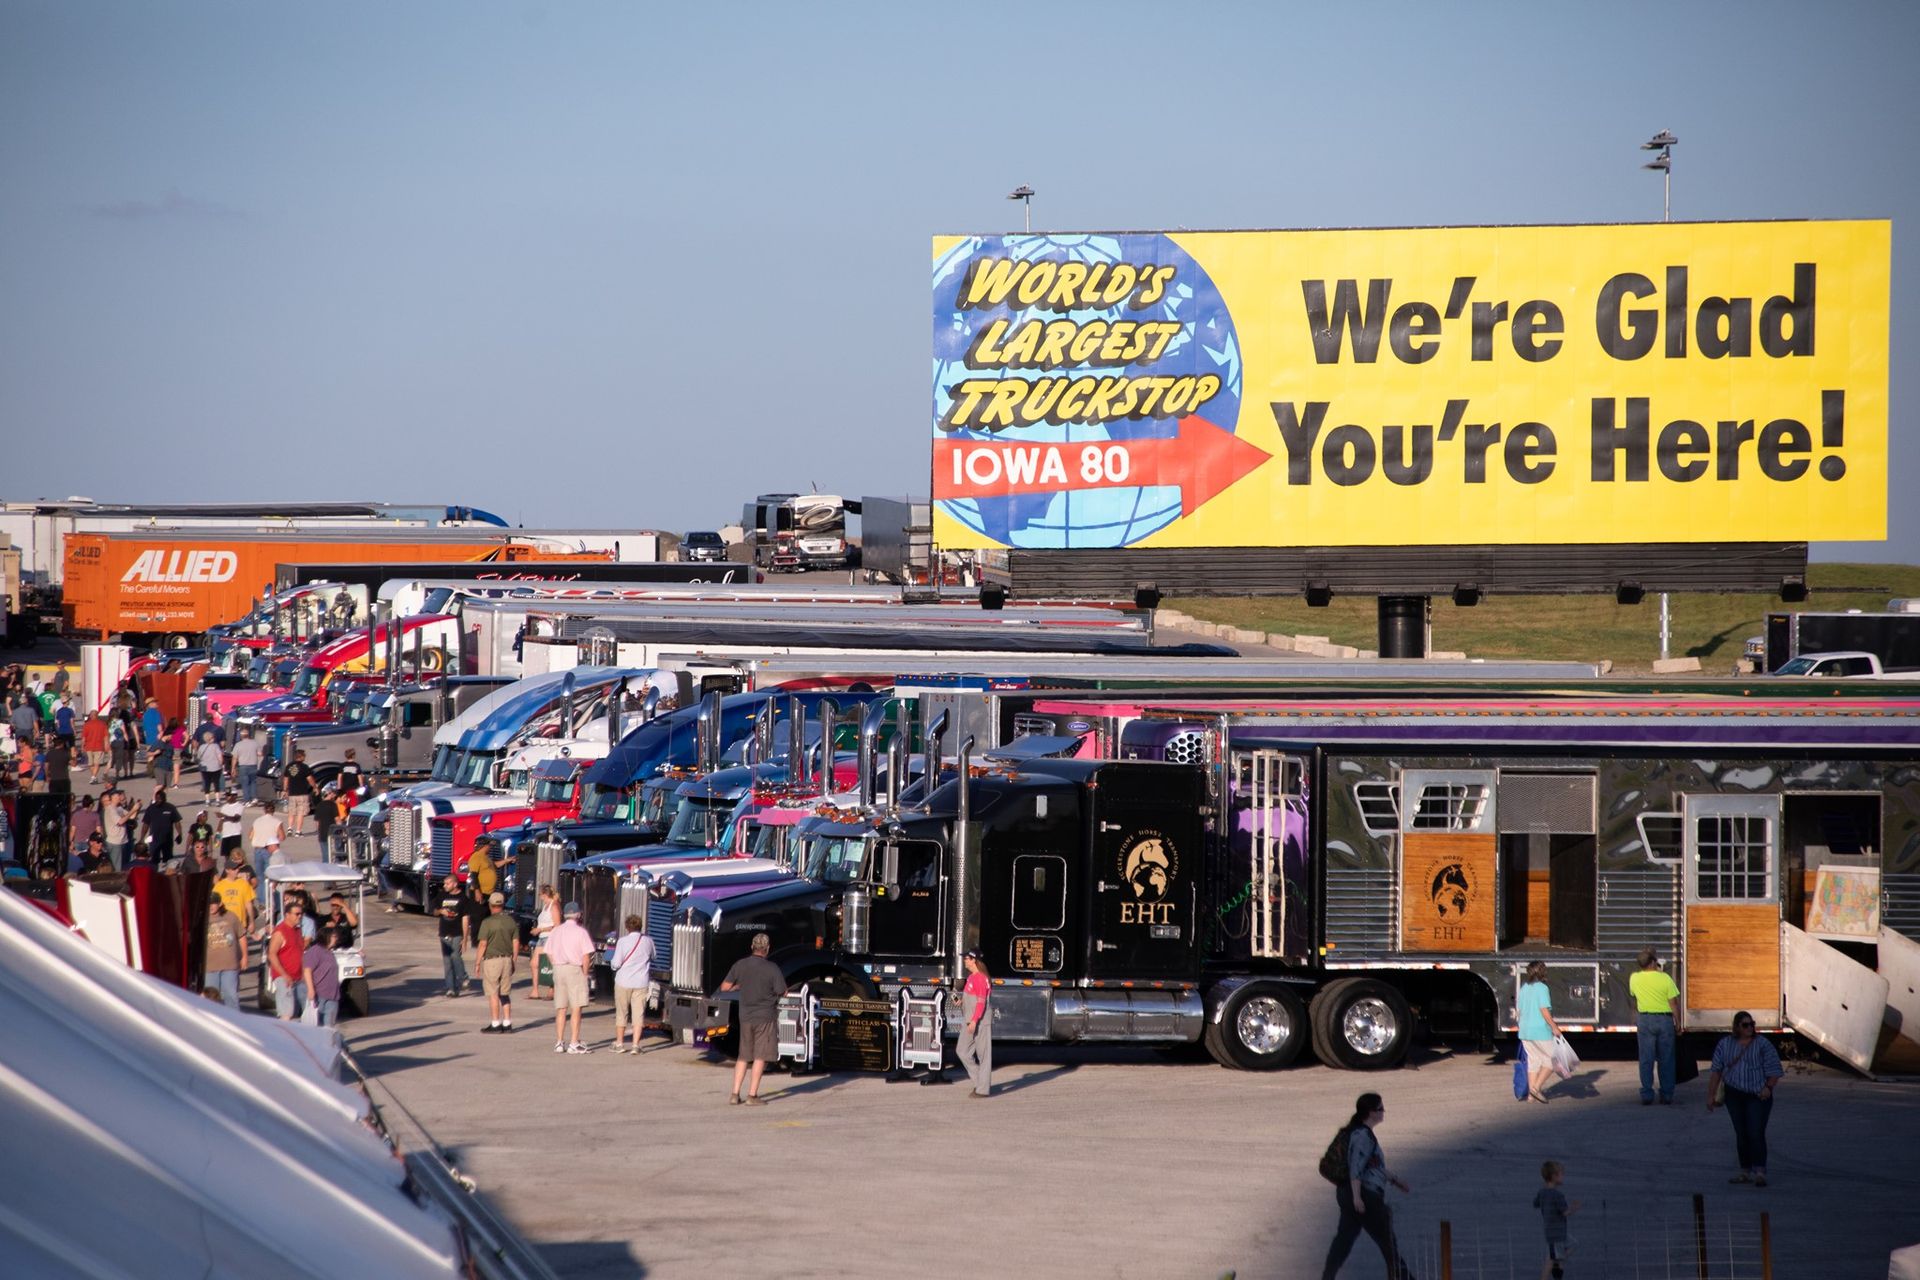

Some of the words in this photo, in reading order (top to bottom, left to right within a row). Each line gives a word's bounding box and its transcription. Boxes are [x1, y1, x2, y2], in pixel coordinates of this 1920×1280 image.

[961, 257, 1176, 310] WORLD'S
[1301, 275, 1566, 365] We're
[1595, 262, 1818, 361] Glad
[967, 319, 1182, 369] LARGEST
[942, 374, 1221, 430] TRUCKSTOP
[1270, 398, 1558, 487] You're
[1590, 389, 1847, 483] Here!
[952, 446, 1068, 486] IOWA
[1080, 445, 1130, 484] 80
[120, 549, 238, 583] ALLIED
[120, 584, 134, 594] The
[135, 584, 162, 594] Careful
[163, 585, 191, 594] Movers
[1120, 902, 1176, 925] EHT
[1433, 926, 1466, 940] EHT
